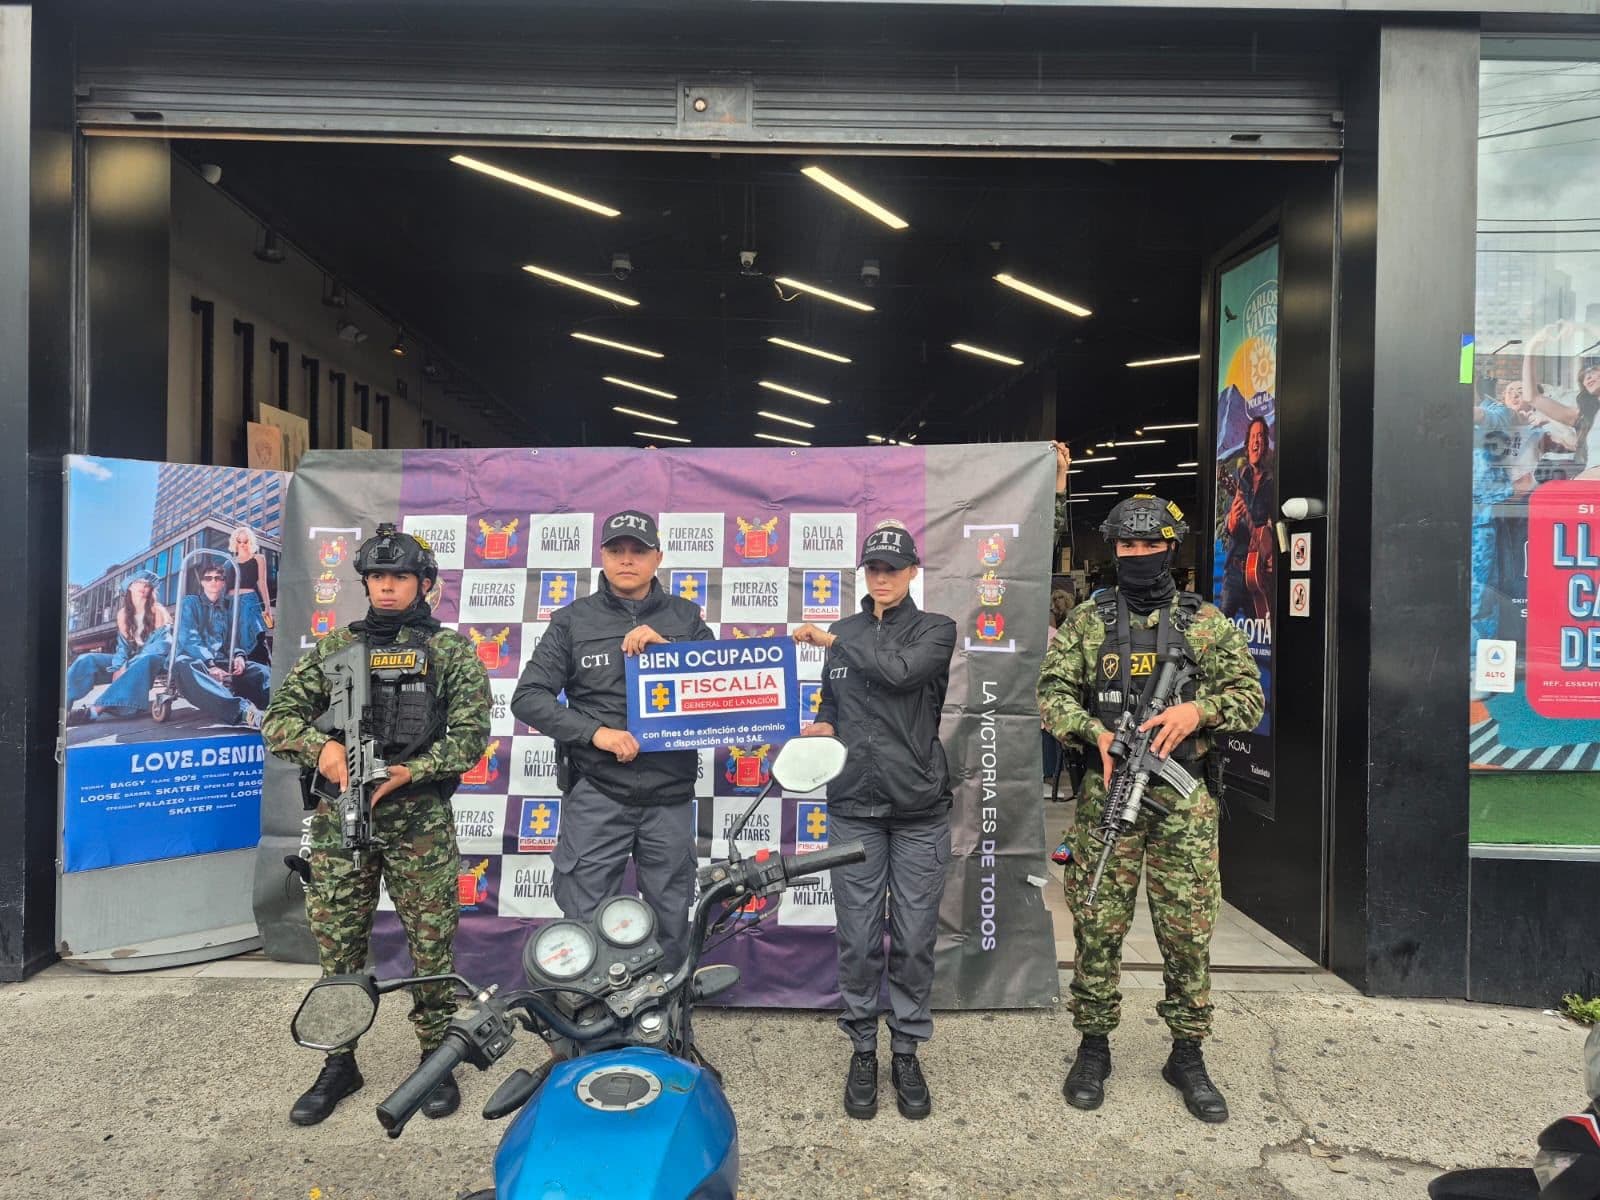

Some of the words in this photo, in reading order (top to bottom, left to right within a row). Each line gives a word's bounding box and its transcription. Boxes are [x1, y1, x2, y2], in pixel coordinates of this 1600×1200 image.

[609, 515, 648, 532] CTI
[541, 527, 580, 539] GAULA
[669, 528, 713, 539] FUERZAS
[802, 527, 843, 539] GAULA
[867, 531, 903, 547] CTI
[432, 541, 456, 553] TARES
[541, 539, 580, 551] MILITAR
[668, 540, 714, 551] MILITARES
[802, 540, 843, 551] MILITAR
[1552, 522, 1599, 567] LL
[471, 583, 515, 595] FUERZAS
[733, 582, 778, 594] FUERZAS
[469, 595, 514, 607] MILITARES
[731, 595, 778, 607] MILITARES
[373, 654, 413, 666] GAULA
[581, 653, 610, 668] CTI
[639, 653, 679, 669] BIEN
[685, 646, 783, 667] OCUPADO
[829, 667, 849, 680] CTI
[681, 672, 777, 694] FISCALÍA
[982, 680, 997, 705] LA
[683, 700, 720, 710] GENERAL
[722, 699, 733, 707] DE
[735, 698, 745, 706] LA
[746, 695, 777, 706] NACIÓN
[643, 731, 659, 739] con
[661, 729, 681, 739] fines
[684, 728, 695, 736] de
[697, 725, 736, 736] extinción
[738, 725, 749, 733] de
[751, 722, 785, 733] dominio
[674, 735, 720, 748] disposición
[723, 735, 734, 744] de
[737, 734, 745, 743] la
[1228, 738, 1251, 754] KOAJ
[525, 750, 556, 764] GAUL
[981, 709, 997, 801] VICTORIA
[524, 764, 558, 777] MILITA
[110, 780, 146, 790] BAGGY
[80, 792, 121, 804] LOOSE
[155, 784, 201, 796] SKATER
[138, 797, 185, 809] PALAZZO
[168, 804, 213, 816] SKATER
[454, 811, 494, 824] UERZAS
[982, 806, 996, 833] ES
[981, 840, 995, 867] DE
[980, 873, 996, 950] TODOS
